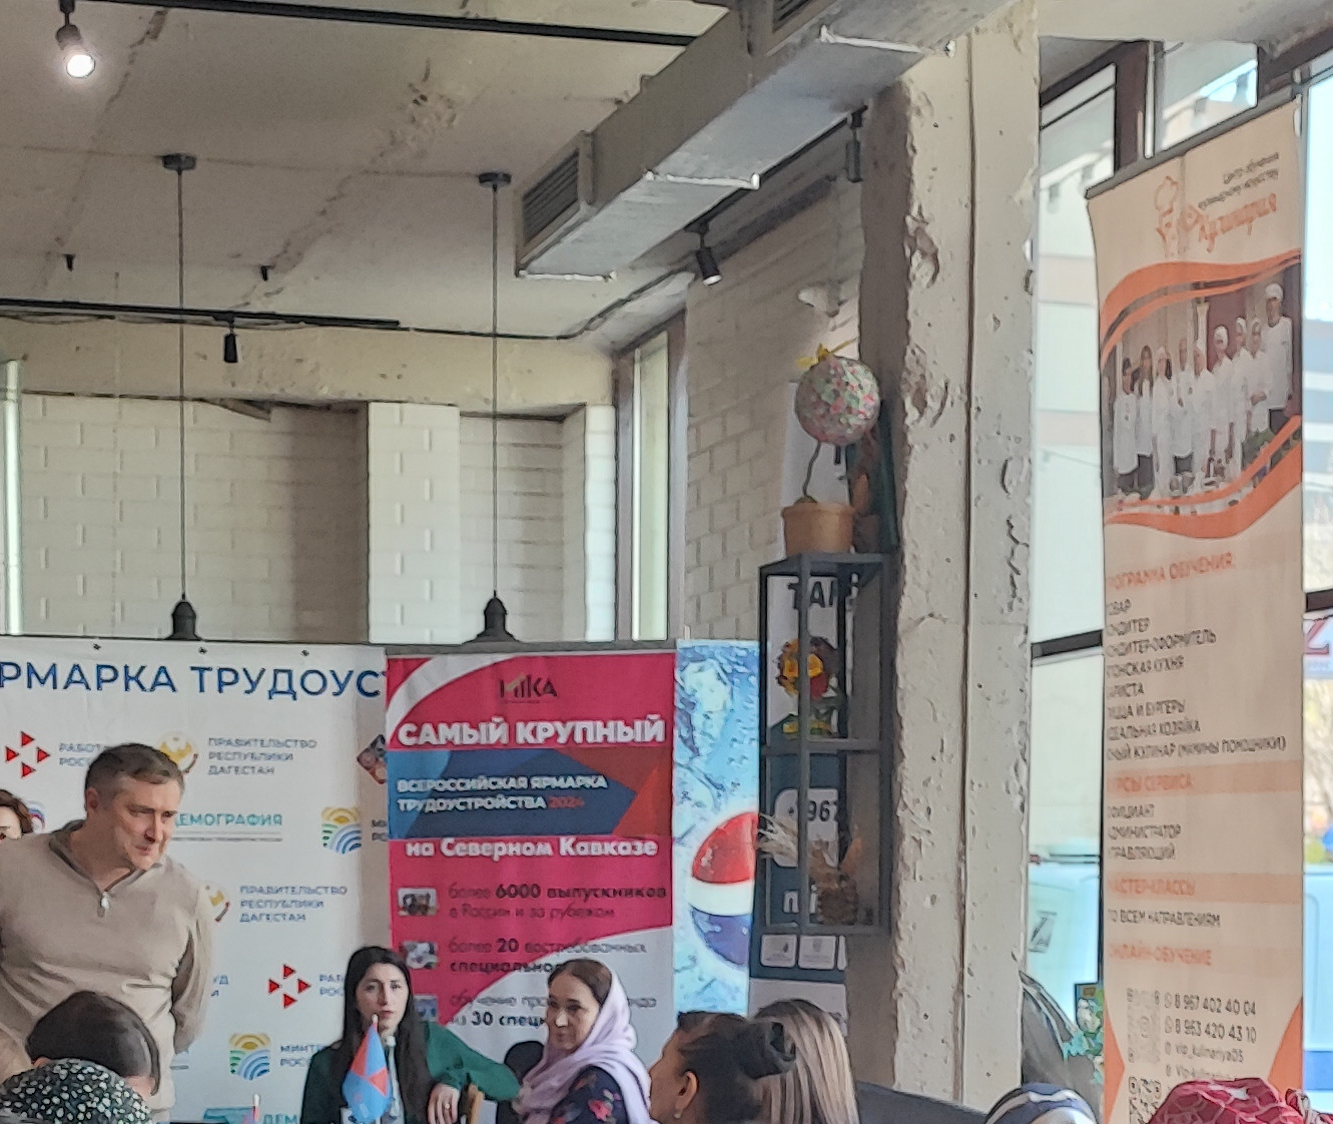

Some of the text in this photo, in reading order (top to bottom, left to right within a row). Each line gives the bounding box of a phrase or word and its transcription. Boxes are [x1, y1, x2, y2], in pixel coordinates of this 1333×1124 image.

[189, 665, 386, 701] ТРУДОУС
[397, 714, 666, 746] САМЫЙ КРУПНЫЙ
[59, 742, 107, 754] РАБОТ
[207, 737, 318, 750] ПРАВИТЕЛЬСТВО
[59, 756, 89, 767] РОС
[207, 750, 295, 762] РЕСПУБЛИКИ
[207, 764, 275, 777] ДАГЕСТАН
[397, 774, 608, 793] ВСЕРОССИЙСКАЯ ЯРМАРКА
[397, 795, 547, 813] ТРУДОУСТРОЙСТВА
[405, 837, 659, 862] на Северном Кавказе
[239, 885, 348, 896] ПРАВИТЕЛЬСТВО
[495, 884, 541, 899] 6000
[546, 886, 667, 903] выпускников
[239, 899, 324, 909] РЕСПУБЛИКИ
[239, 912, 306, 923] ДАГЕСТАН
[496, 937, 518, 952] 20
[450, 961, 562, 975] специально
[471, 1010, 493, 1026] 30
